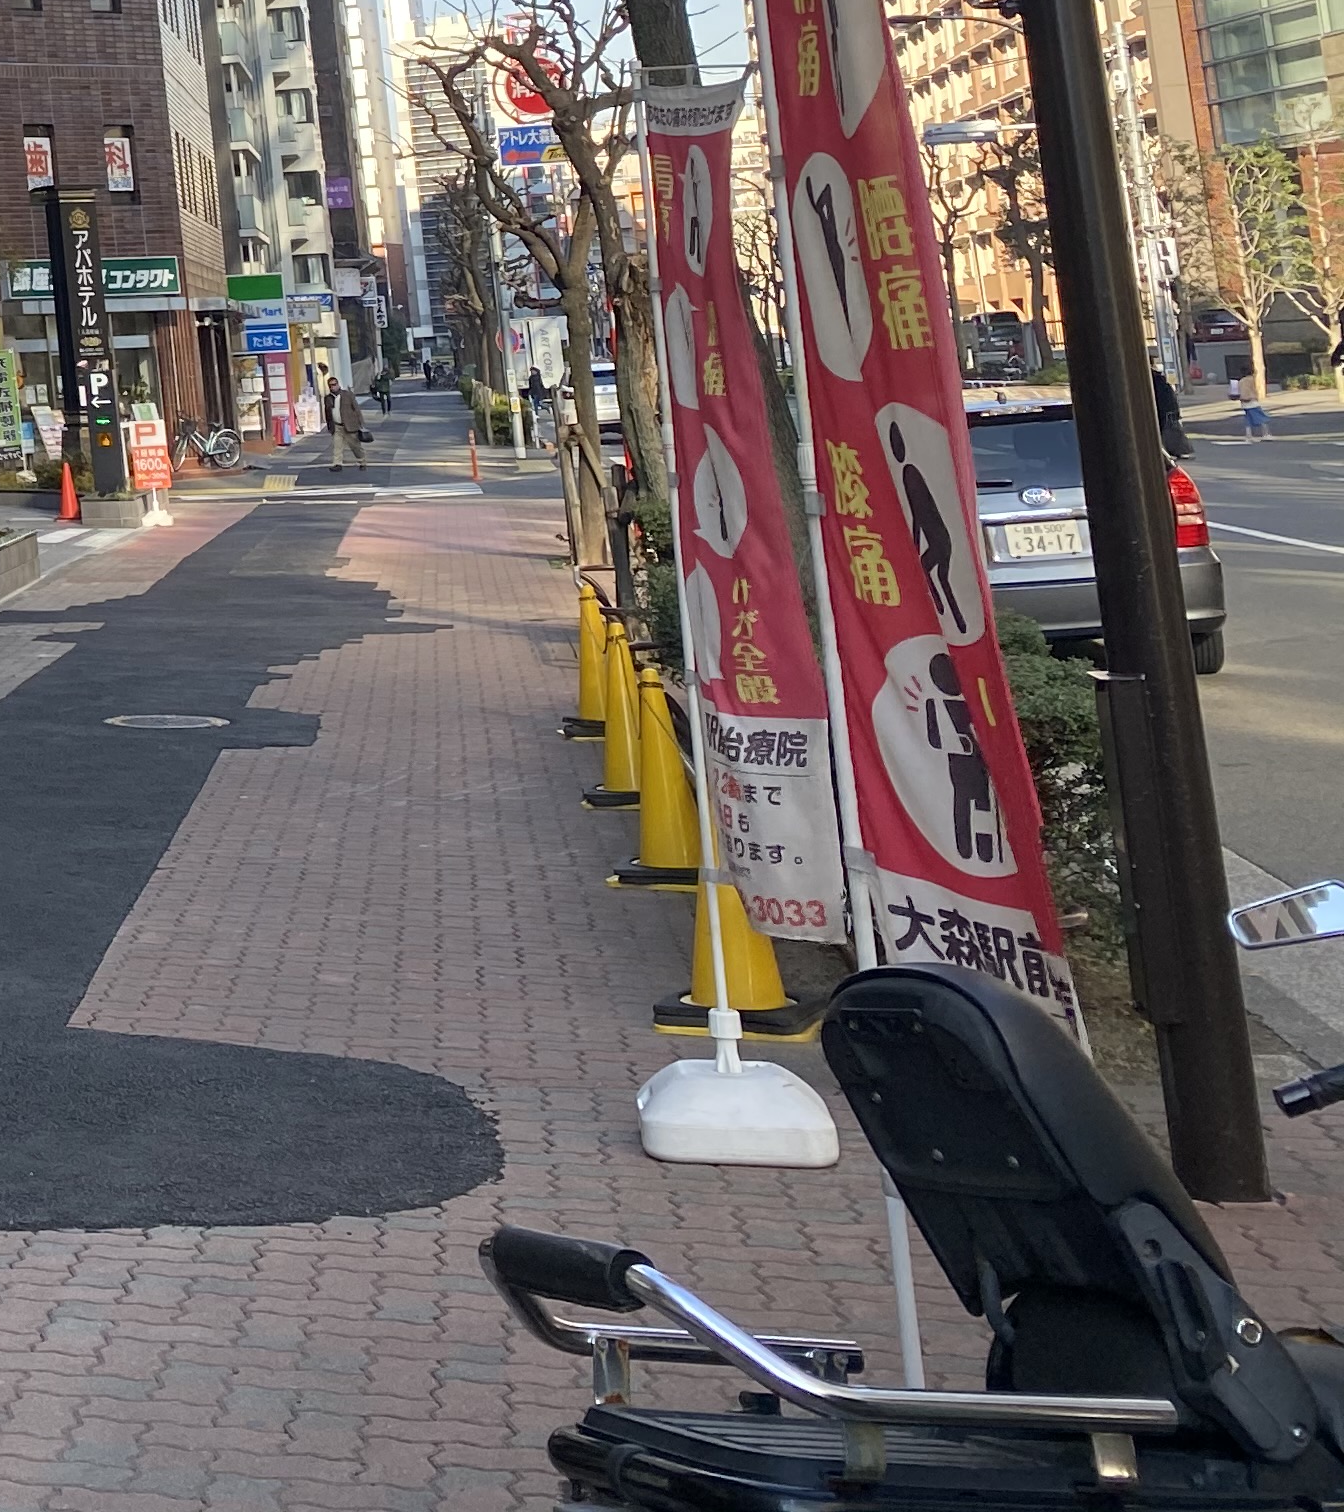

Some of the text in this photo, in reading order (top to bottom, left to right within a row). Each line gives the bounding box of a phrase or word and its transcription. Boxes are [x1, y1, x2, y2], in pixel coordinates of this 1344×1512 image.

[12, 266, 174, 291] 銀座 コンタクト
[72, 230, 98, 327] アパホテル
[252, 335, 283, 348] たばこ
[90, 373, 109, 396] P
[135, 423, 157, 445] P
[1023, 533, 1075, 553] 34-17
[746, 894, 827, 928] 3033
